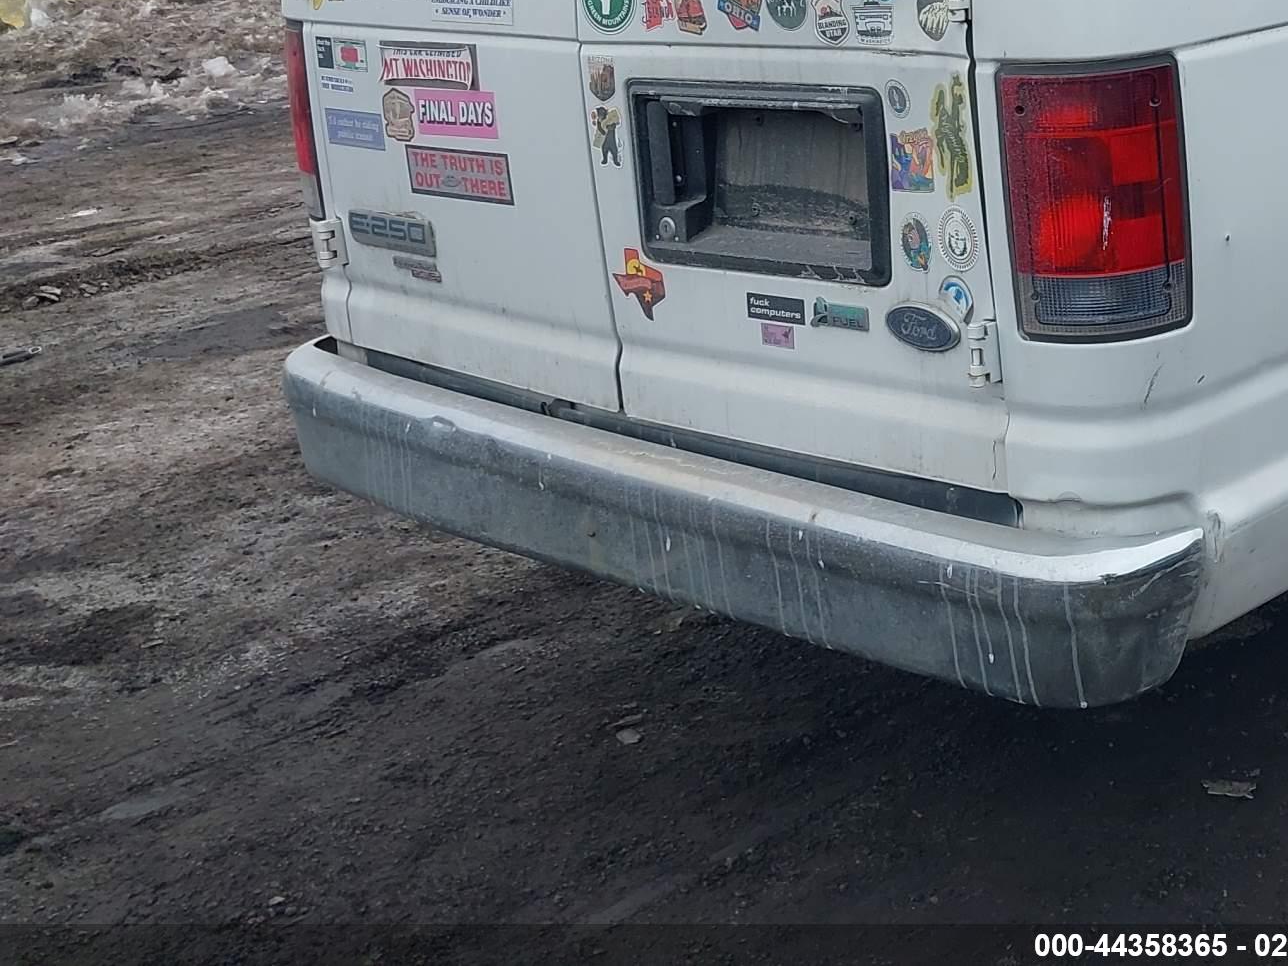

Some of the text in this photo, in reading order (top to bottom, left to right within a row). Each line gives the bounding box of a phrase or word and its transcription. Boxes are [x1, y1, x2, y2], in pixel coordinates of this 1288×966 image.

[442, 7, 460, 16] SENSE
[472, 8, 502, 18] WONDER
[587, 0, 630, 26] GREEN MOUNTAINS
[724, 1, 754, 24] OHIO
[817, 19, 847, 30] BLANDING
[825, 29, 843, 38] UTAH
[384, 57, 400, 79] MT
[418, 99, 458, 126] FINAL
[459, 100, 495, 128] DAYS
[412, 151, 504, 176] THE TRUTH IS
[415, 172, 507, 197] OUT THERE
[750, 296, 802, 320] fuck computers
[832, 316, 864, 329] FUEL
[901, 312, 937, 340] Ford
